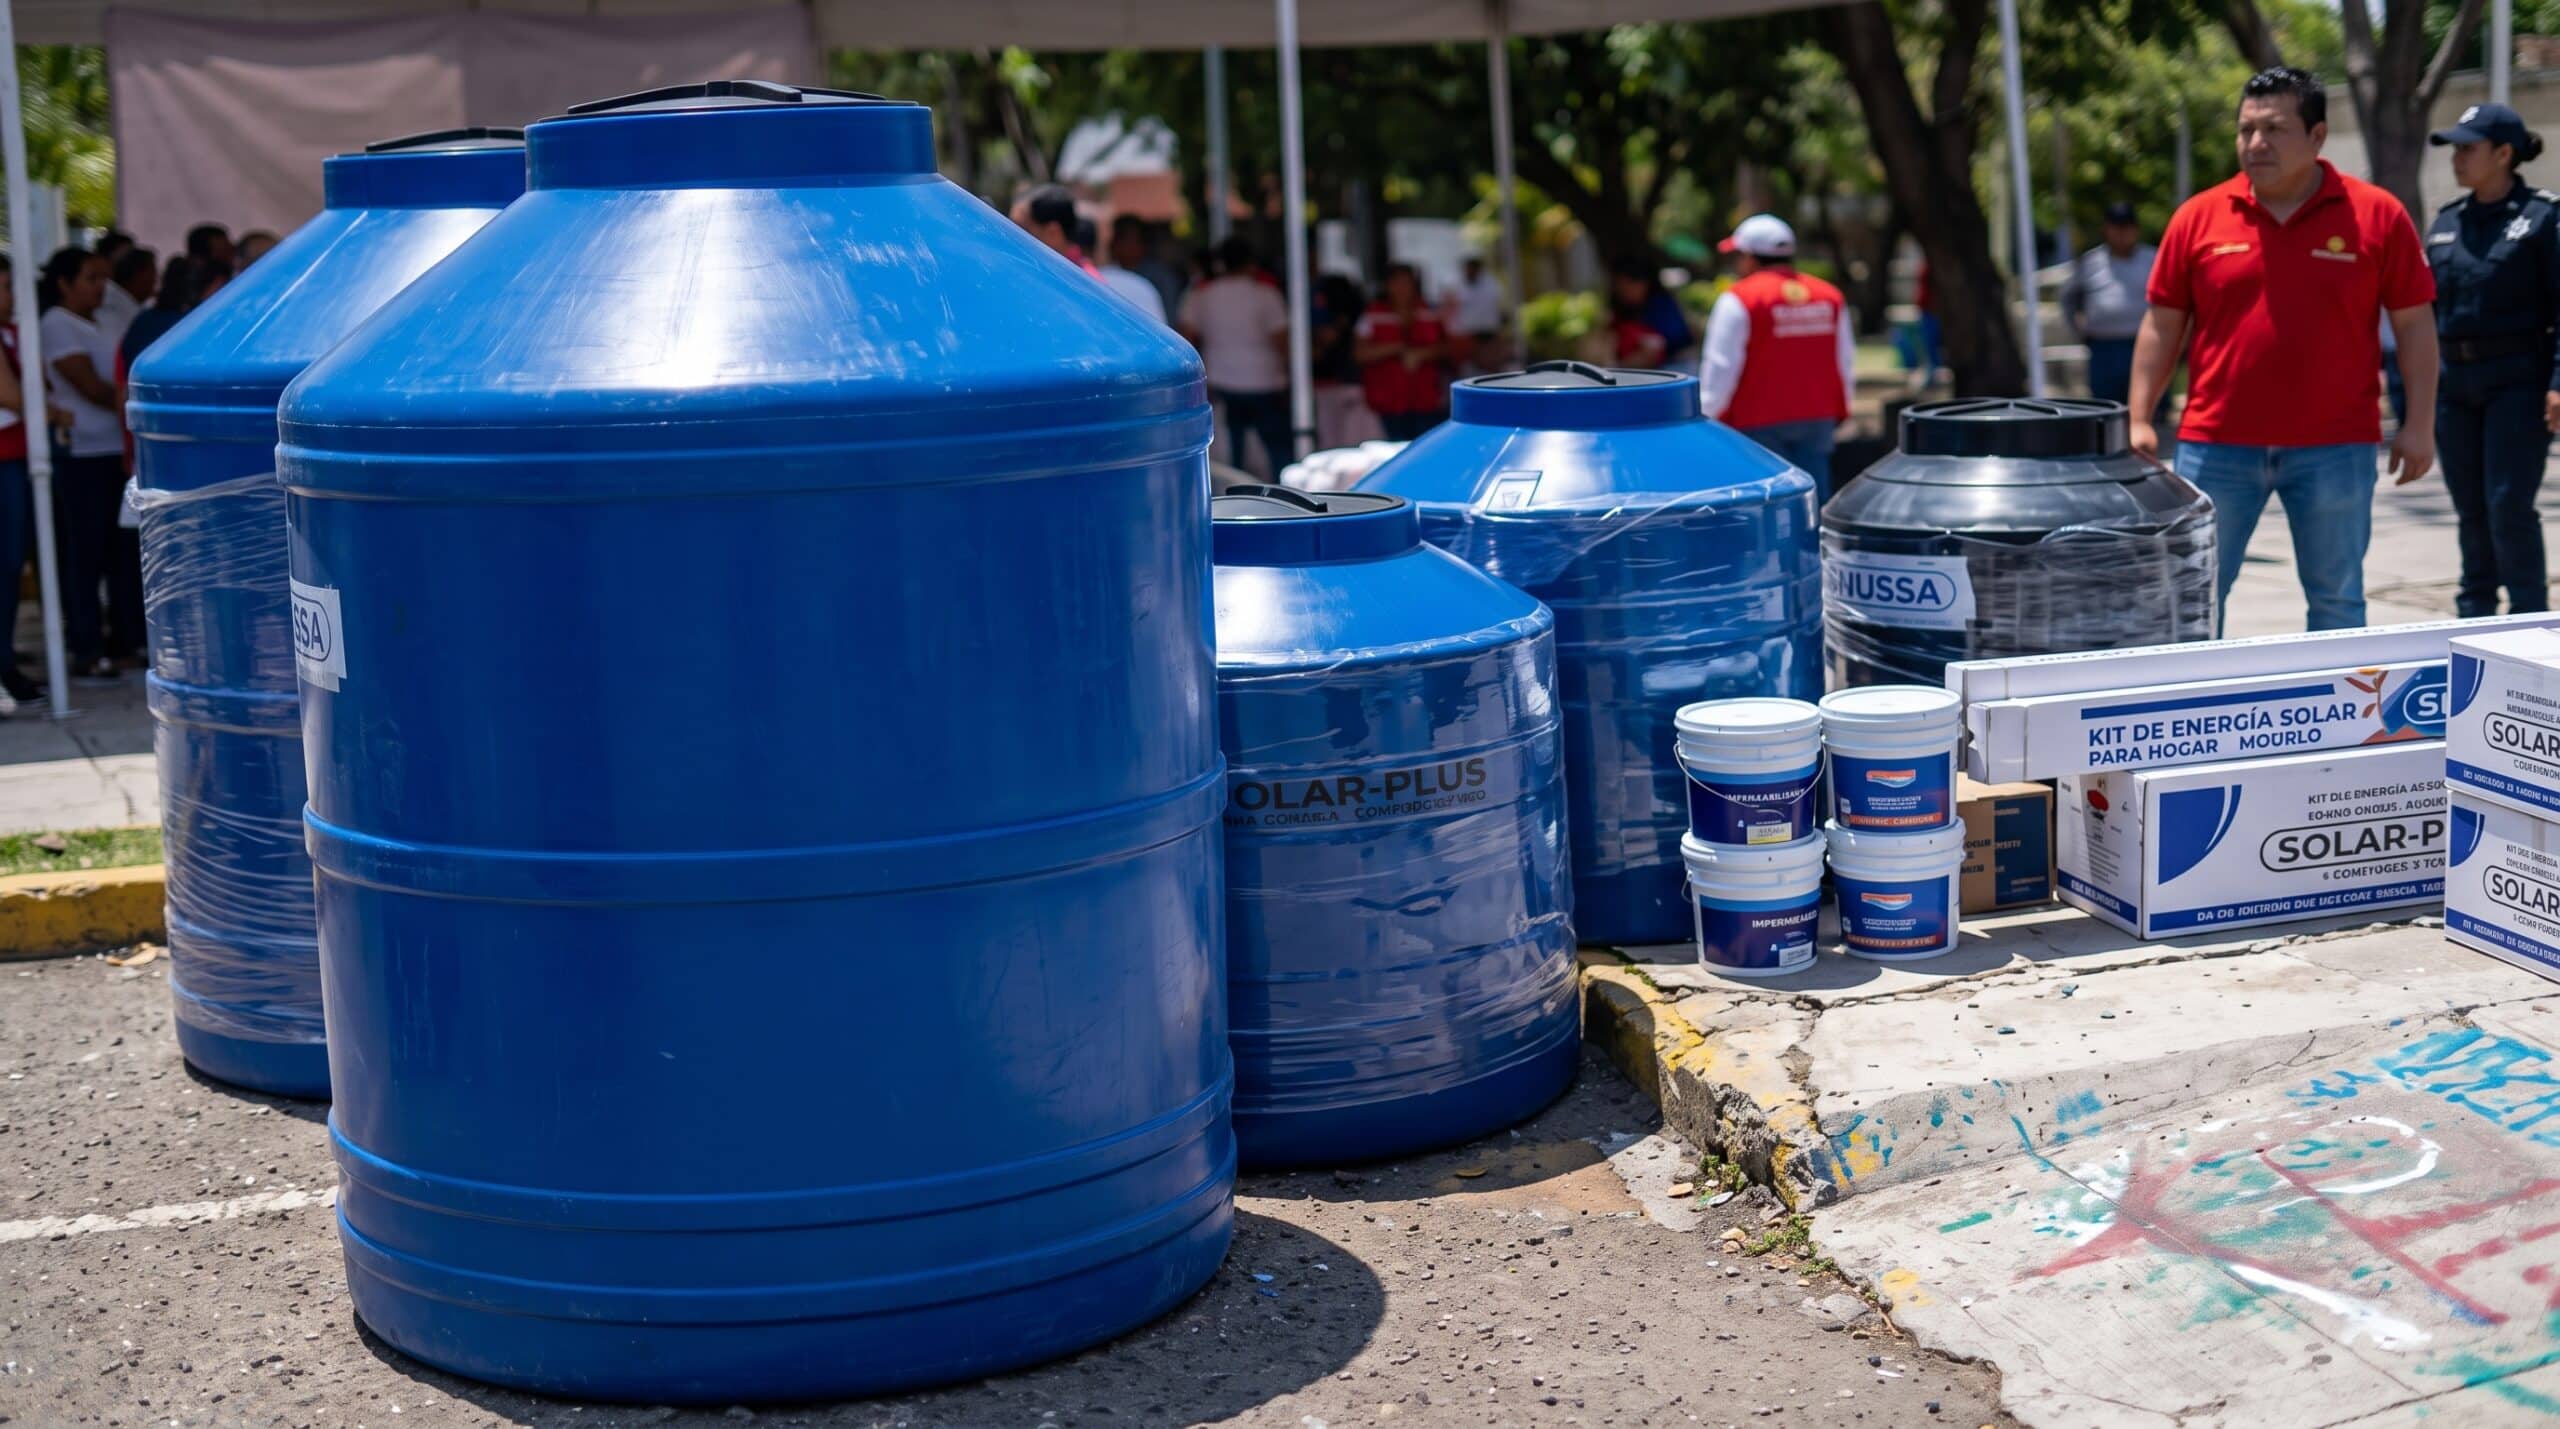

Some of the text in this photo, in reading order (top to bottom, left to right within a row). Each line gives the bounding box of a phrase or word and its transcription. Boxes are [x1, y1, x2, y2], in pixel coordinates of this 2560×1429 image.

[2088, 702, 2357, 747] KIT DE ENERGÍA SOLAR
[2088, 747, 2142, 767] PARA
[2148, 739, 2218, 761] HOGAR
[2308, 793, 2328, 805] KIT
[2278, 820, 2445, 863] SOLAR-P
